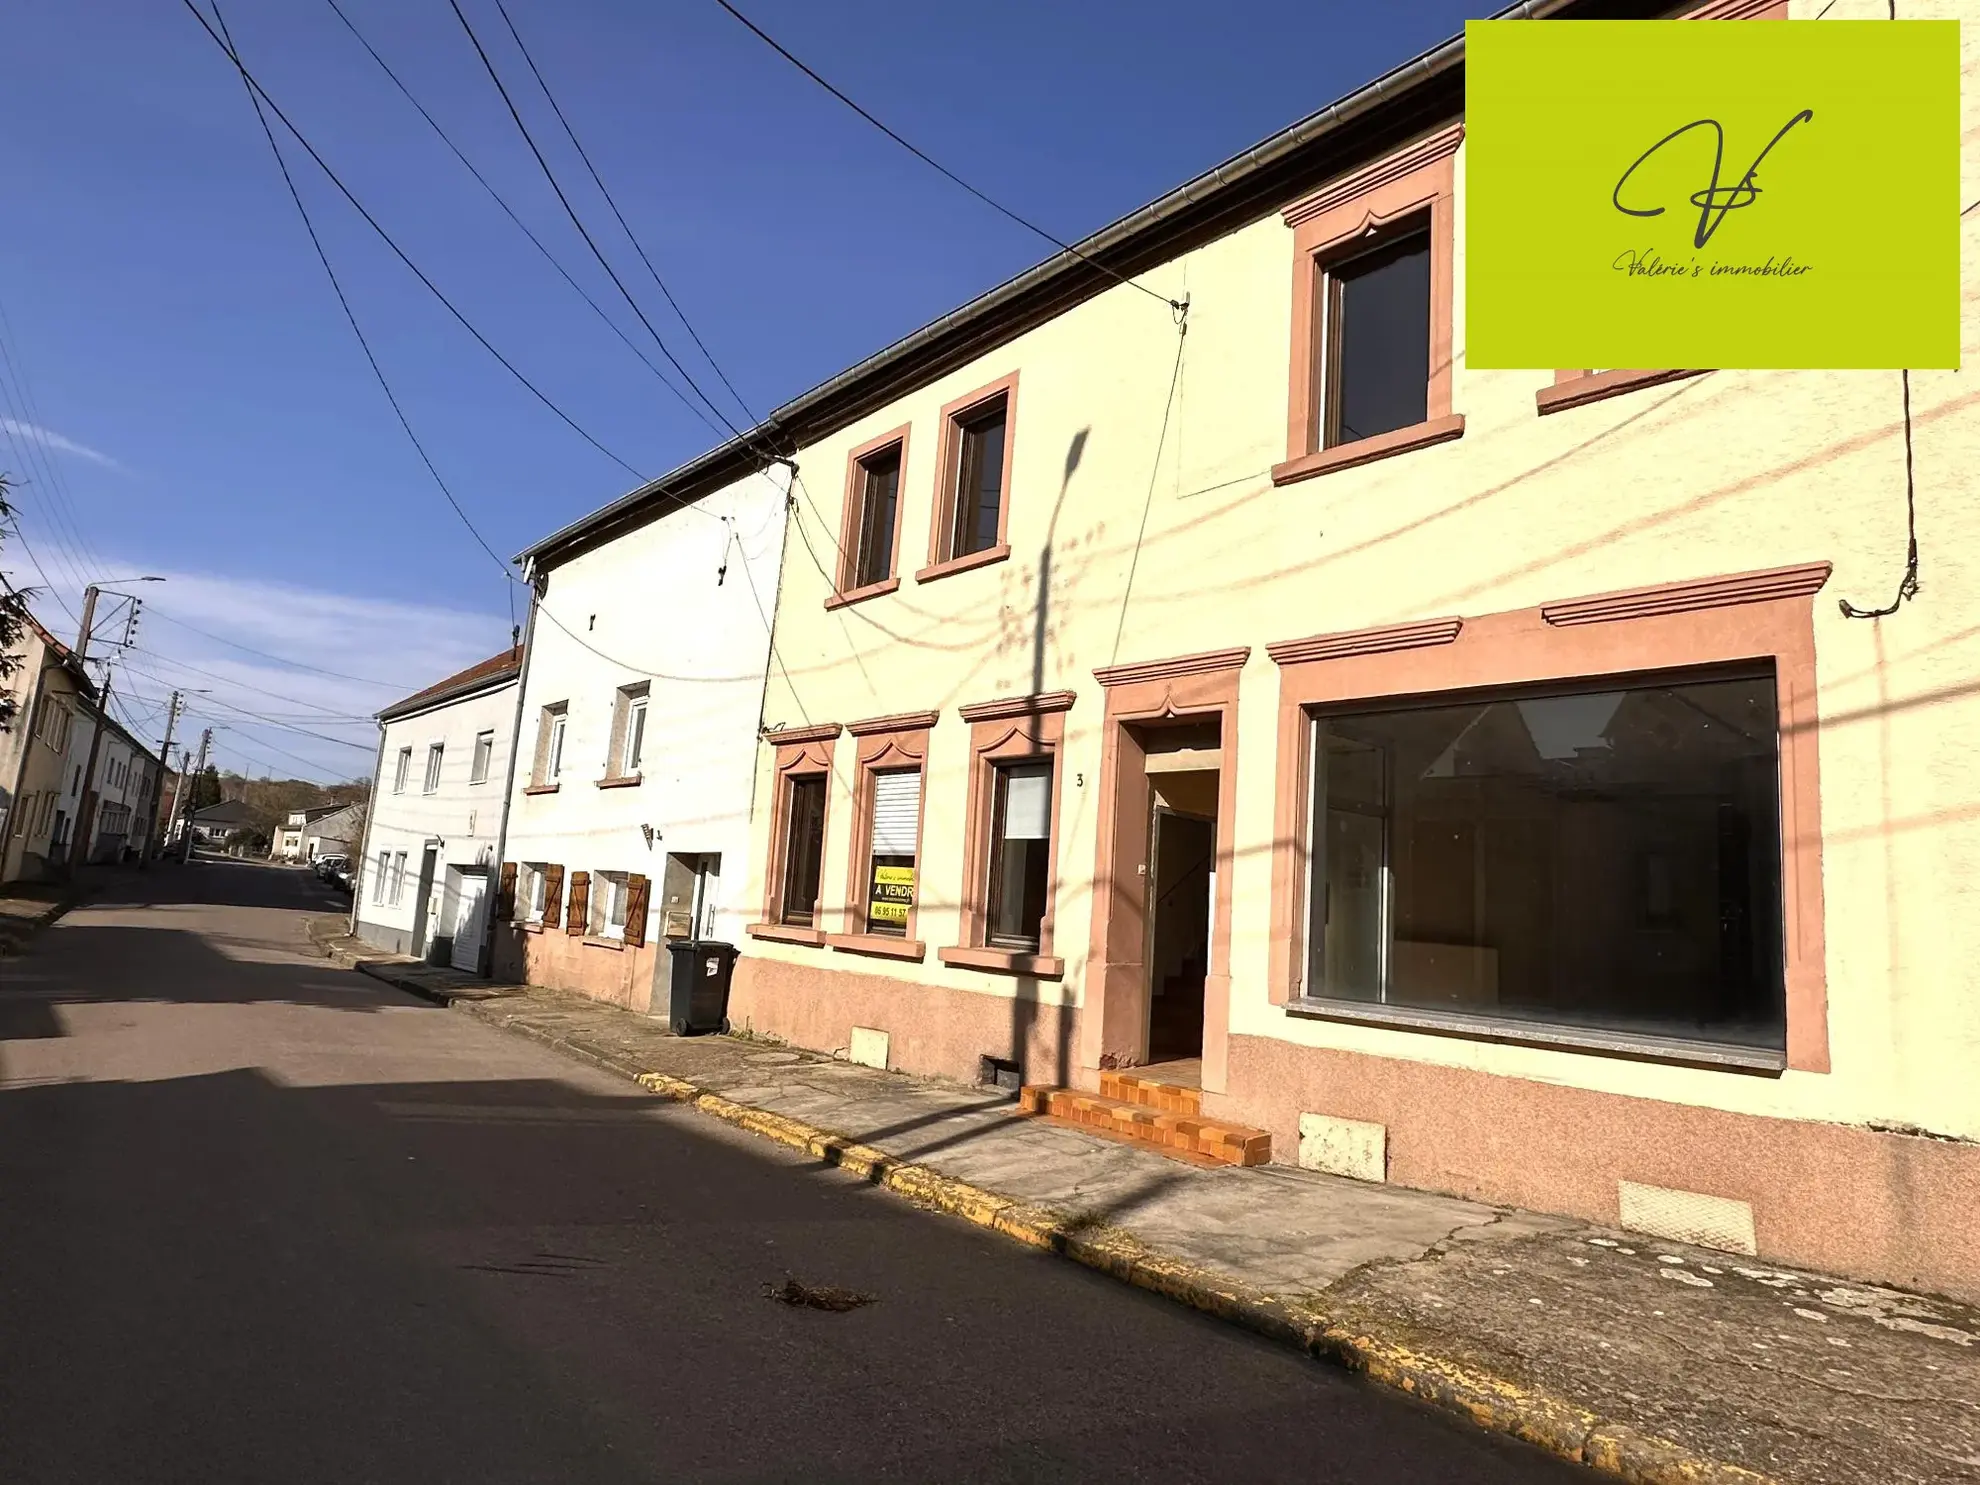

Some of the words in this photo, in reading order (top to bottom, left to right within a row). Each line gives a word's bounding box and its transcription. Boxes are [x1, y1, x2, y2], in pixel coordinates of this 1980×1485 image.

[1076, 773, 1084, 788] 3
[875, 884, 882, 895] A
[886, 884, 914, 897] VENDR
